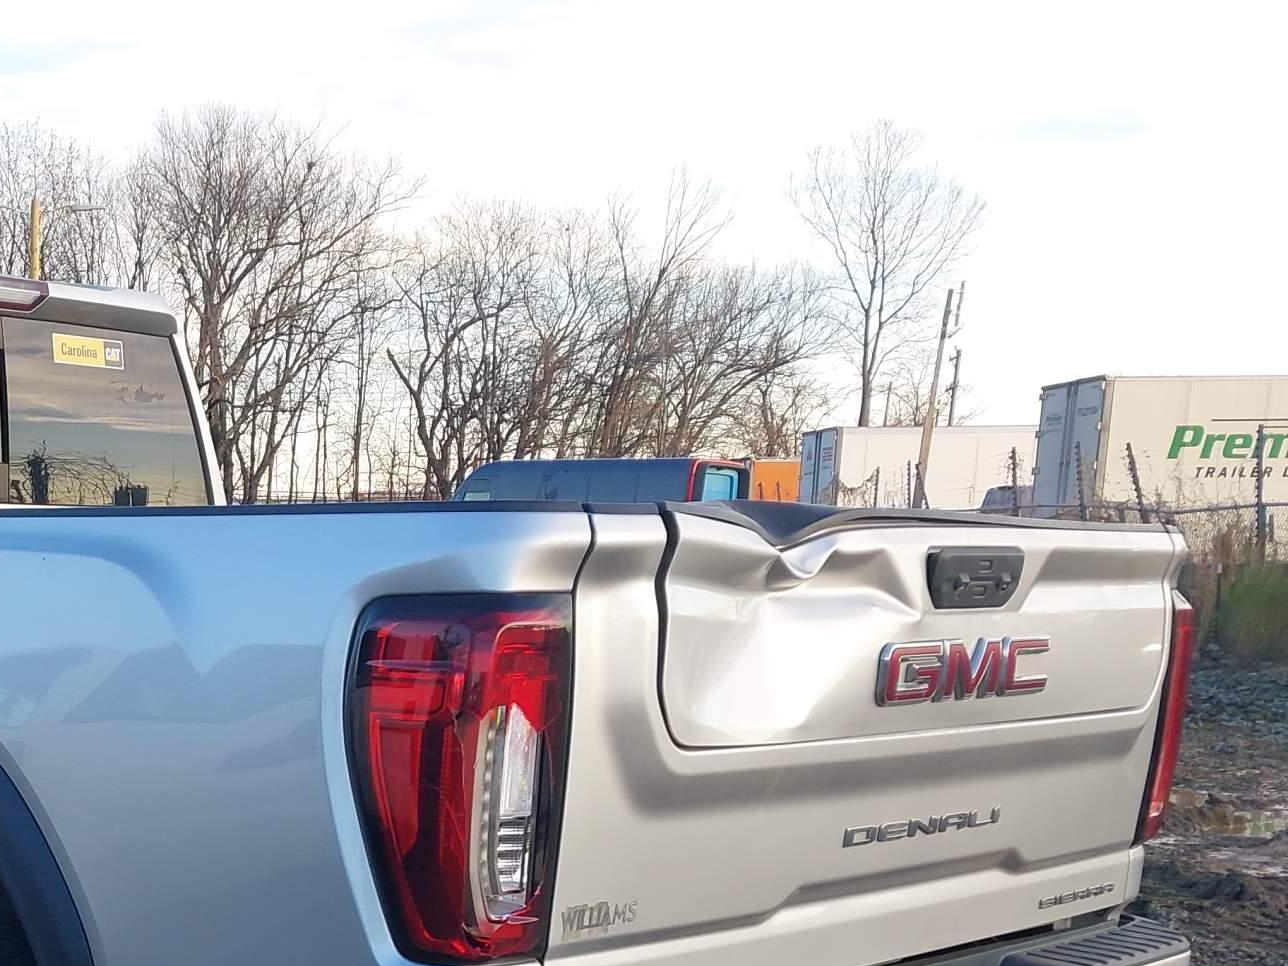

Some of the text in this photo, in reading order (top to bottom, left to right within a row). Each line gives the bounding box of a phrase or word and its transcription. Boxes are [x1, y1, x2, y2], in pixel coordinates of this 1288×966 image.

[61, 342, 121, 361] Carolina CAT
[1195, 466, 1273, 478] TRAILER
[874, 636, 1050, 707] GMC
[842, 805, 1001, 848] DENALI
[1038, 882, 1114, 910] SIERRA
